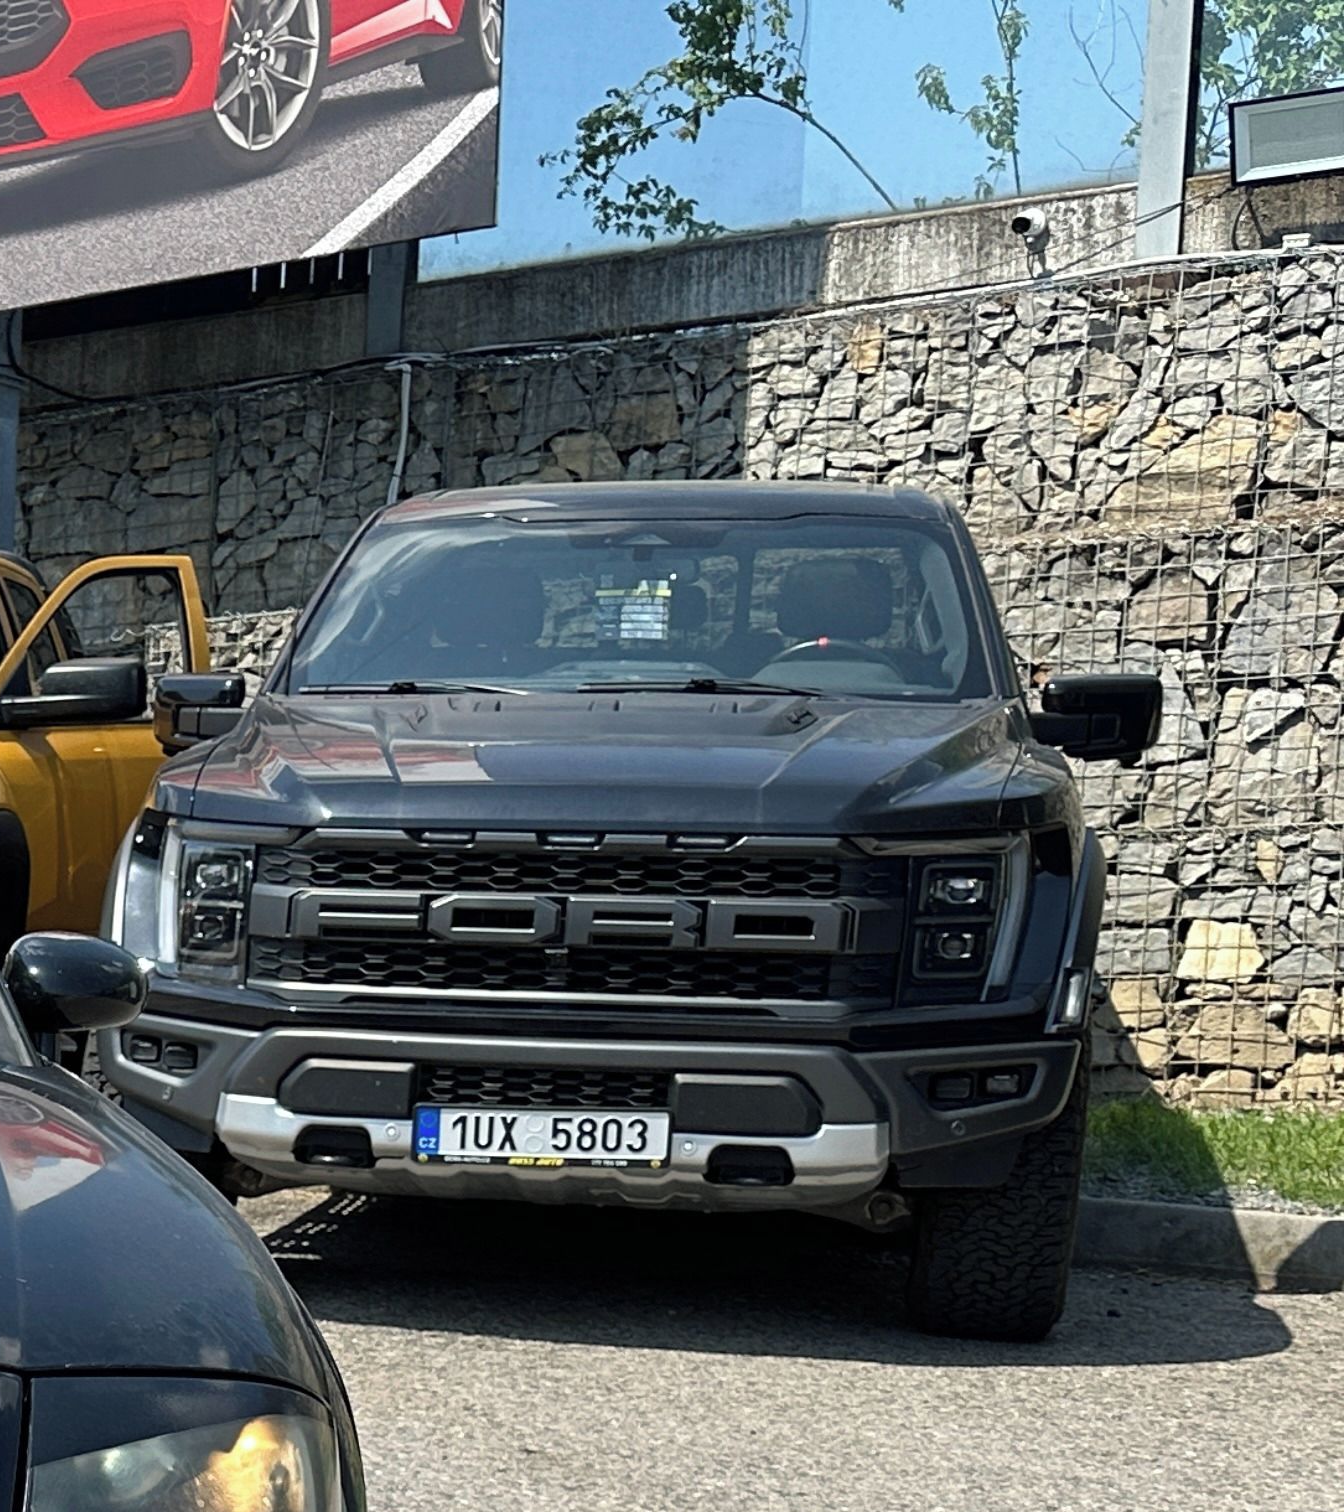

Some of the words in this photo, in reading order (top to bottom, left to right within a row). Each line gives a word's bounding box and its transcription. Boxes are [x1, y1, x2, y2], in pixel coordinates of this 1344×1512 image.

[292, 888, 857, 953] FORD
[418, 1136, 437, 1149] CZ
[452, 1114, 518, 1151] 1UX
[551, 1117, 648, 1153] 5803
